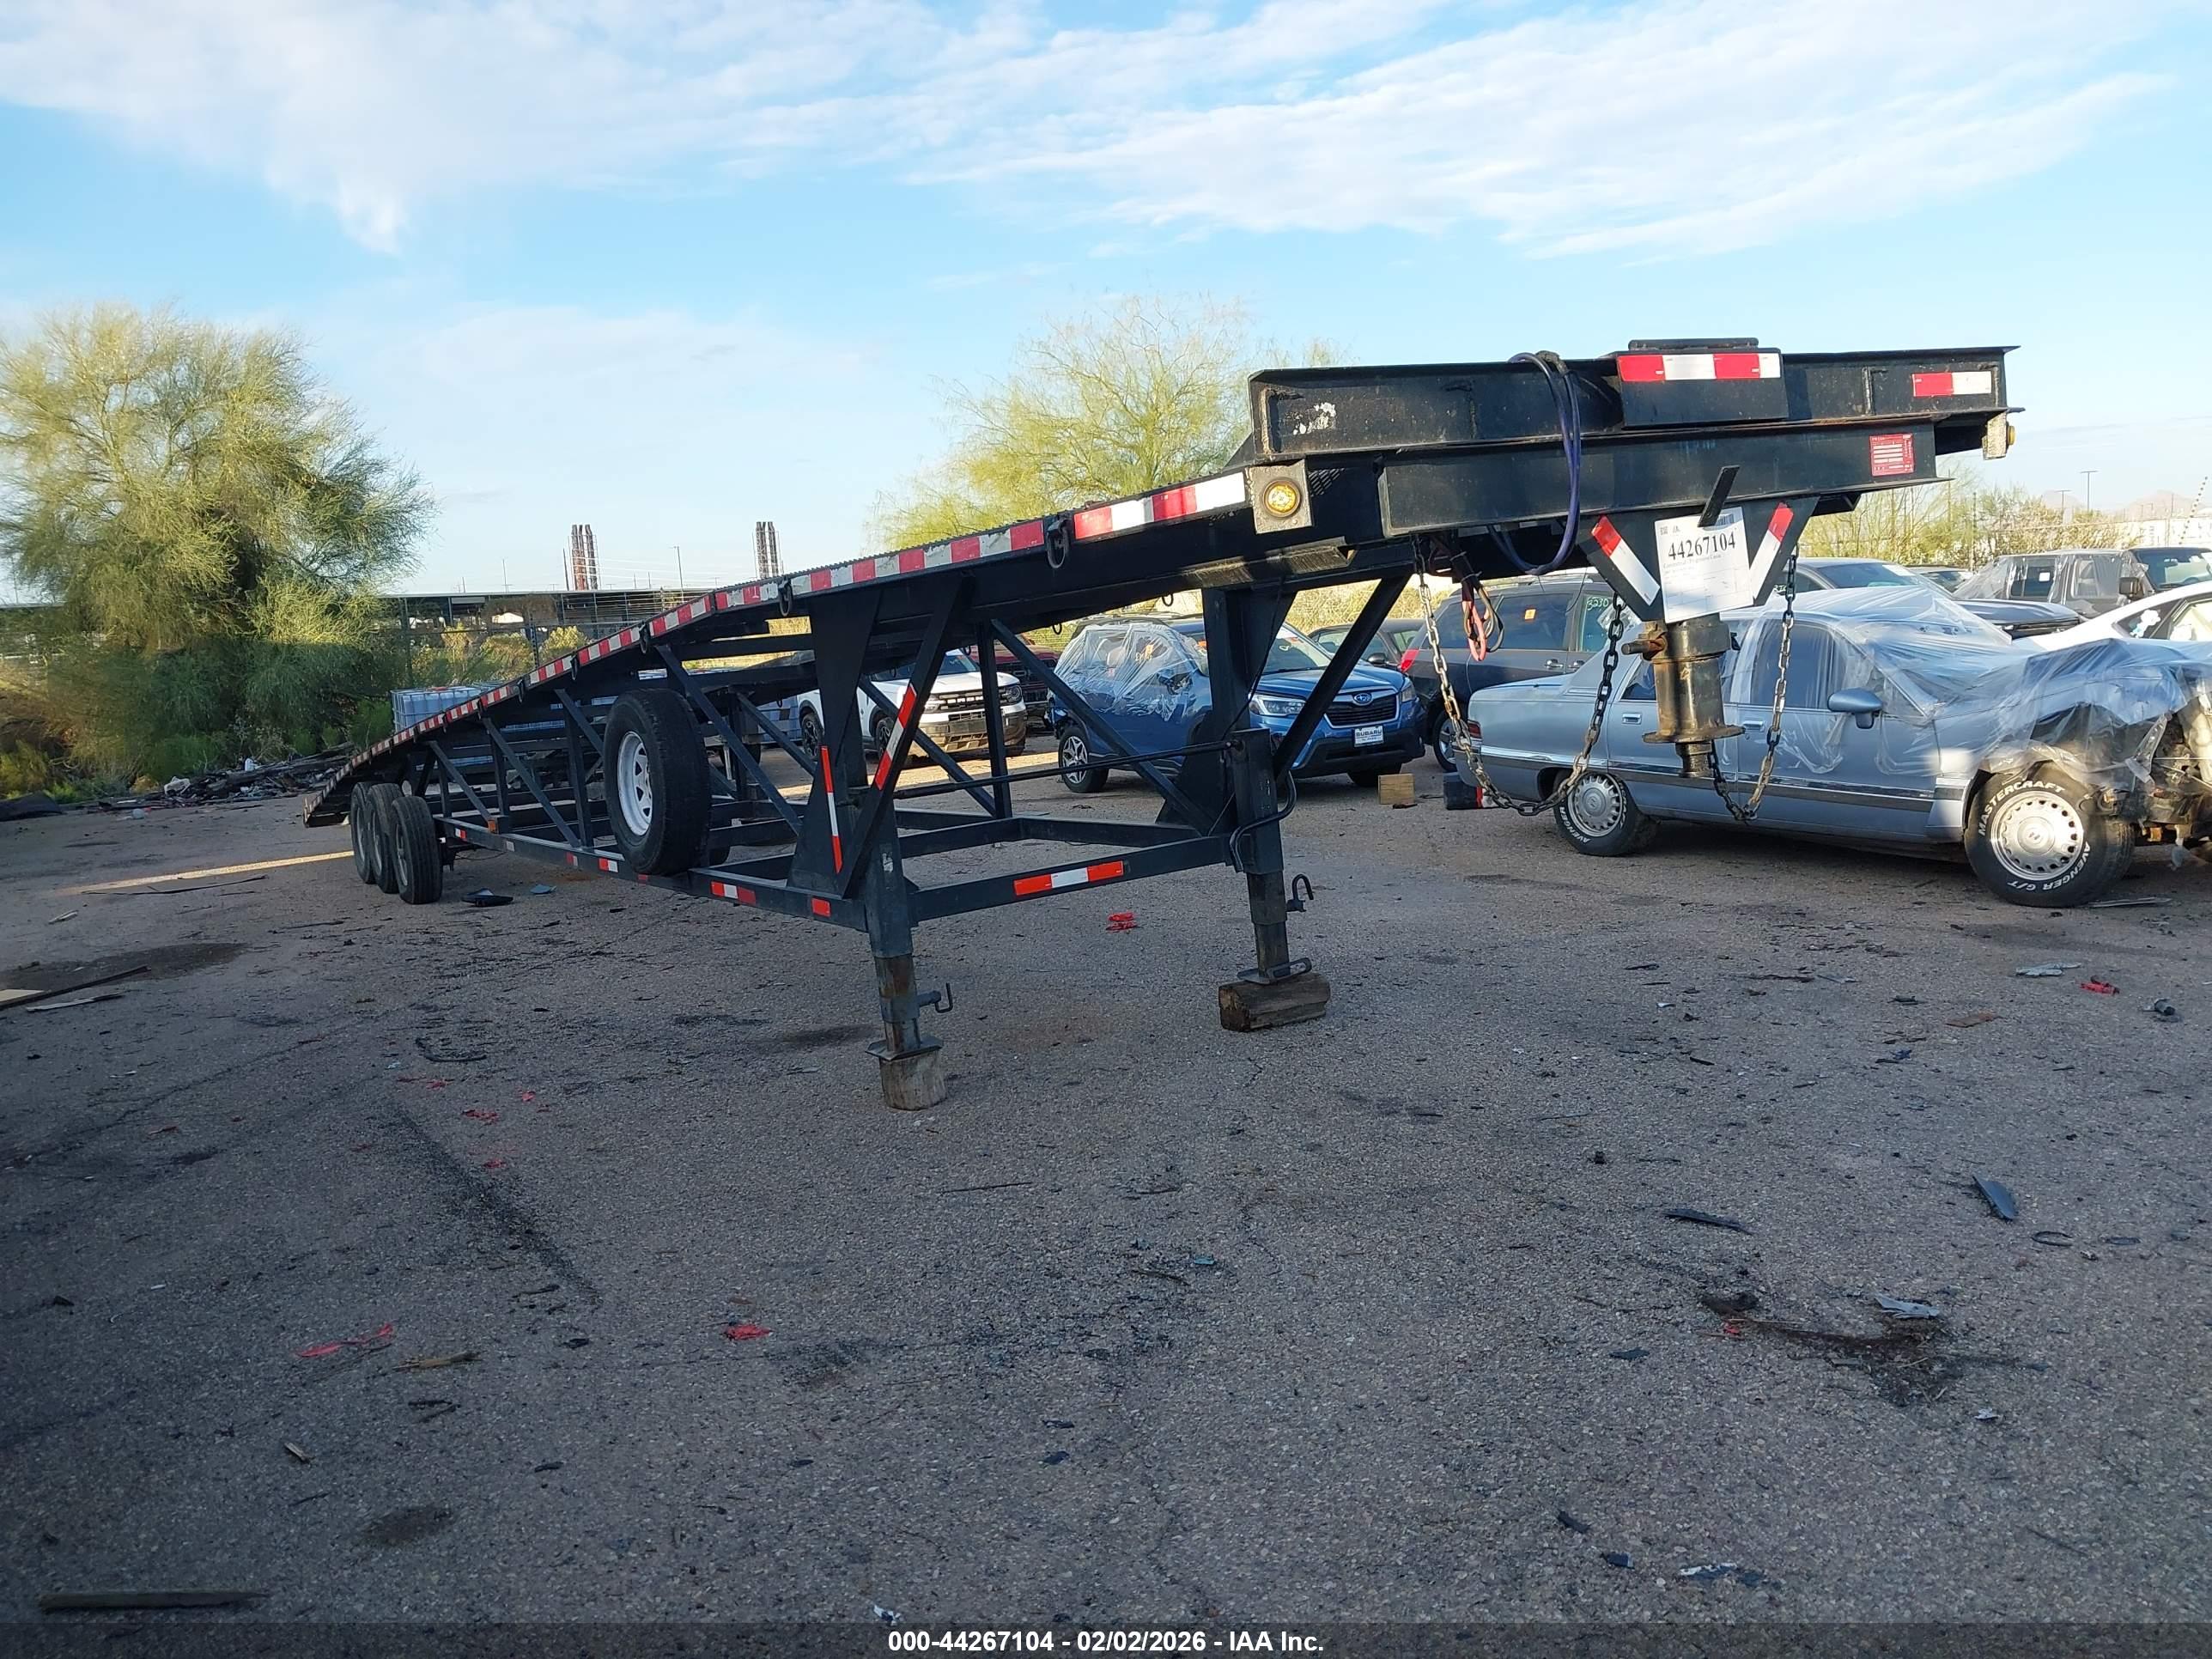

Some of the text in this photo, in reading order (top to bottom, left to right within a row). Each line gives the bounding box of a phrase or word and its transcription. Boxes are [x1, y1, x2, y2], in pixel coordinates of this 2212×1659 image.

[1668, 531, 1736, 561] 44267104
[1559, 806, 1591, 843] AVENGER
[1978, 780, 2066, 836] MASTERCRAFT
[2008, 841, 2091, 891] AVENGER G/T
